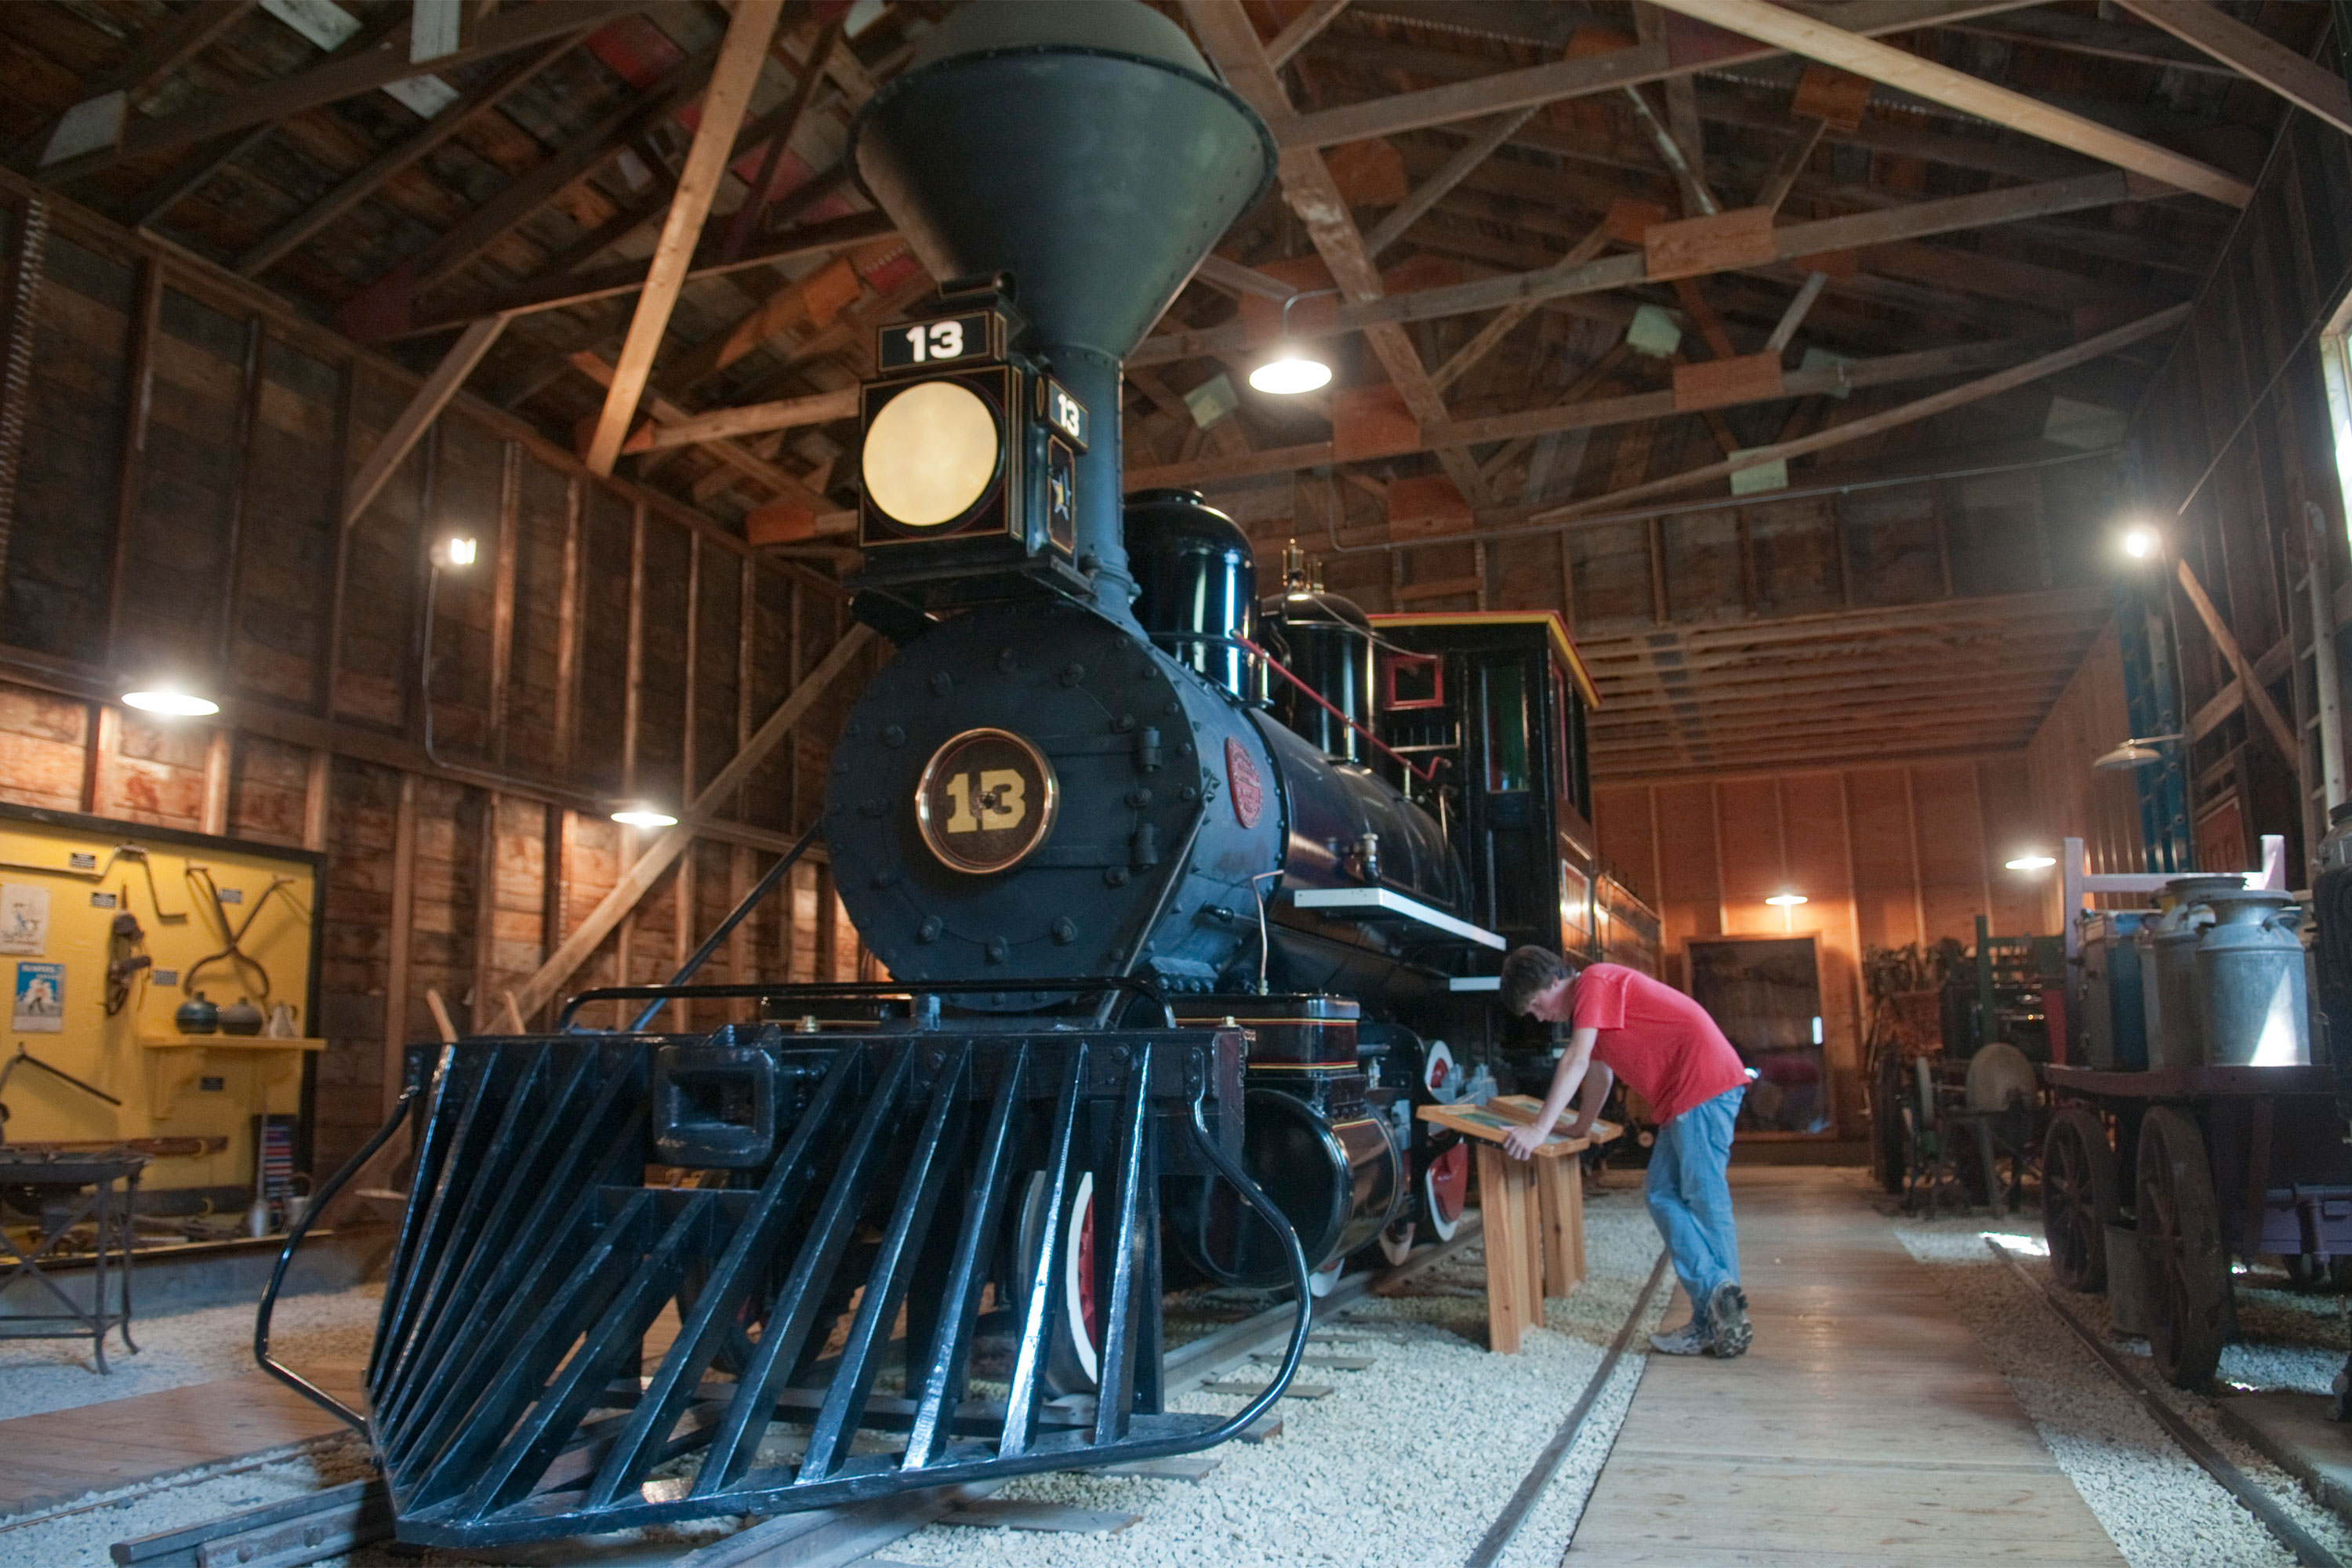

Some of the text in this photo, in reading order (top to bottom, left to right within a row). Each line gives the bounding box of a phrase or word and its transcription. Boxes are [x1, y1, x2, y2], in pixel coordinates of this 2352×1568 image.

[906, 320, 964, 362] 13
[1057, 393, 1080, 437] 13
[946, 768, 1026, 834] 13
